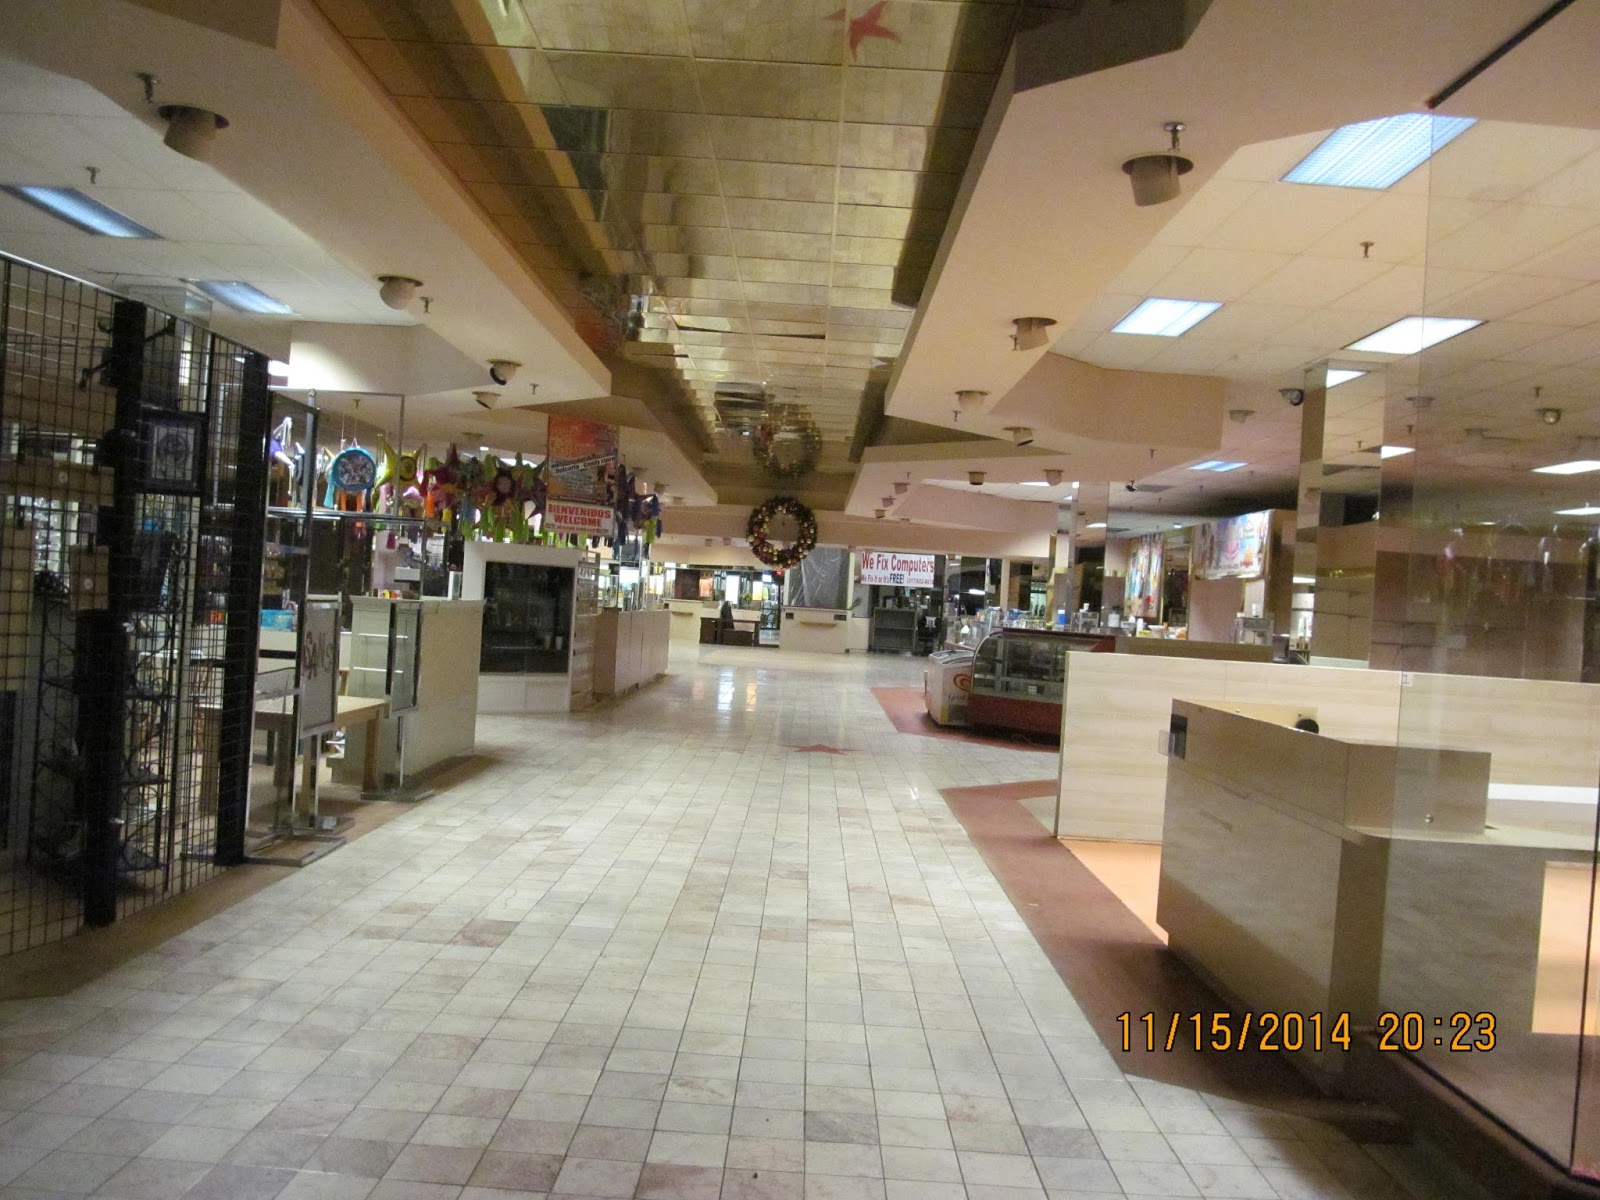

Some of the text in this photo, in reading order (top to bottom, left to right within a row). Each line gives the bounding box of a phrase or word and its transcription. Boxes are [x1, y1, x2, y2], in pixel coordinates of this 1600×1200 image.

[548, 503, 611, 519] BIENVENIDOS
[554, 514, 602, 527] WELCOME
[862, 553, 934, 576] We Fix Computers
[889, 573, 904, 584] FREE!
